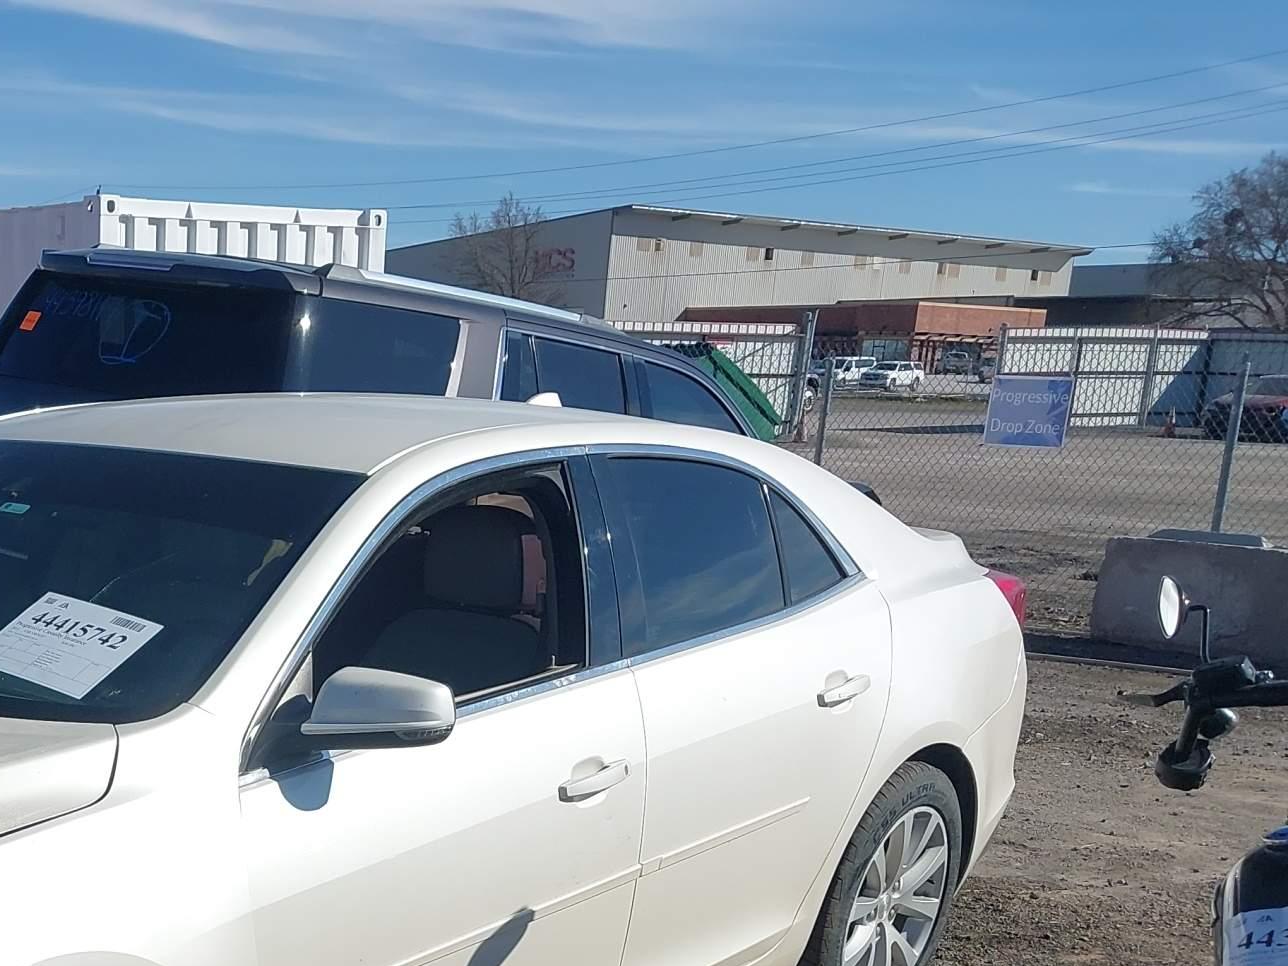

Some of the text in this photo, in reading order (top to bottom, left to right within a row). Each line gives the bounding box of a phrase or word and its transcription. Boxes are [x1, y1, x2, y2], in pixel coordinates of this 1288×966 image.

[993, 388, 1069, 406] Progressive
[990, 418, 1060, 435] Drop Zone
[31, 612, 128, 650] 44415742
